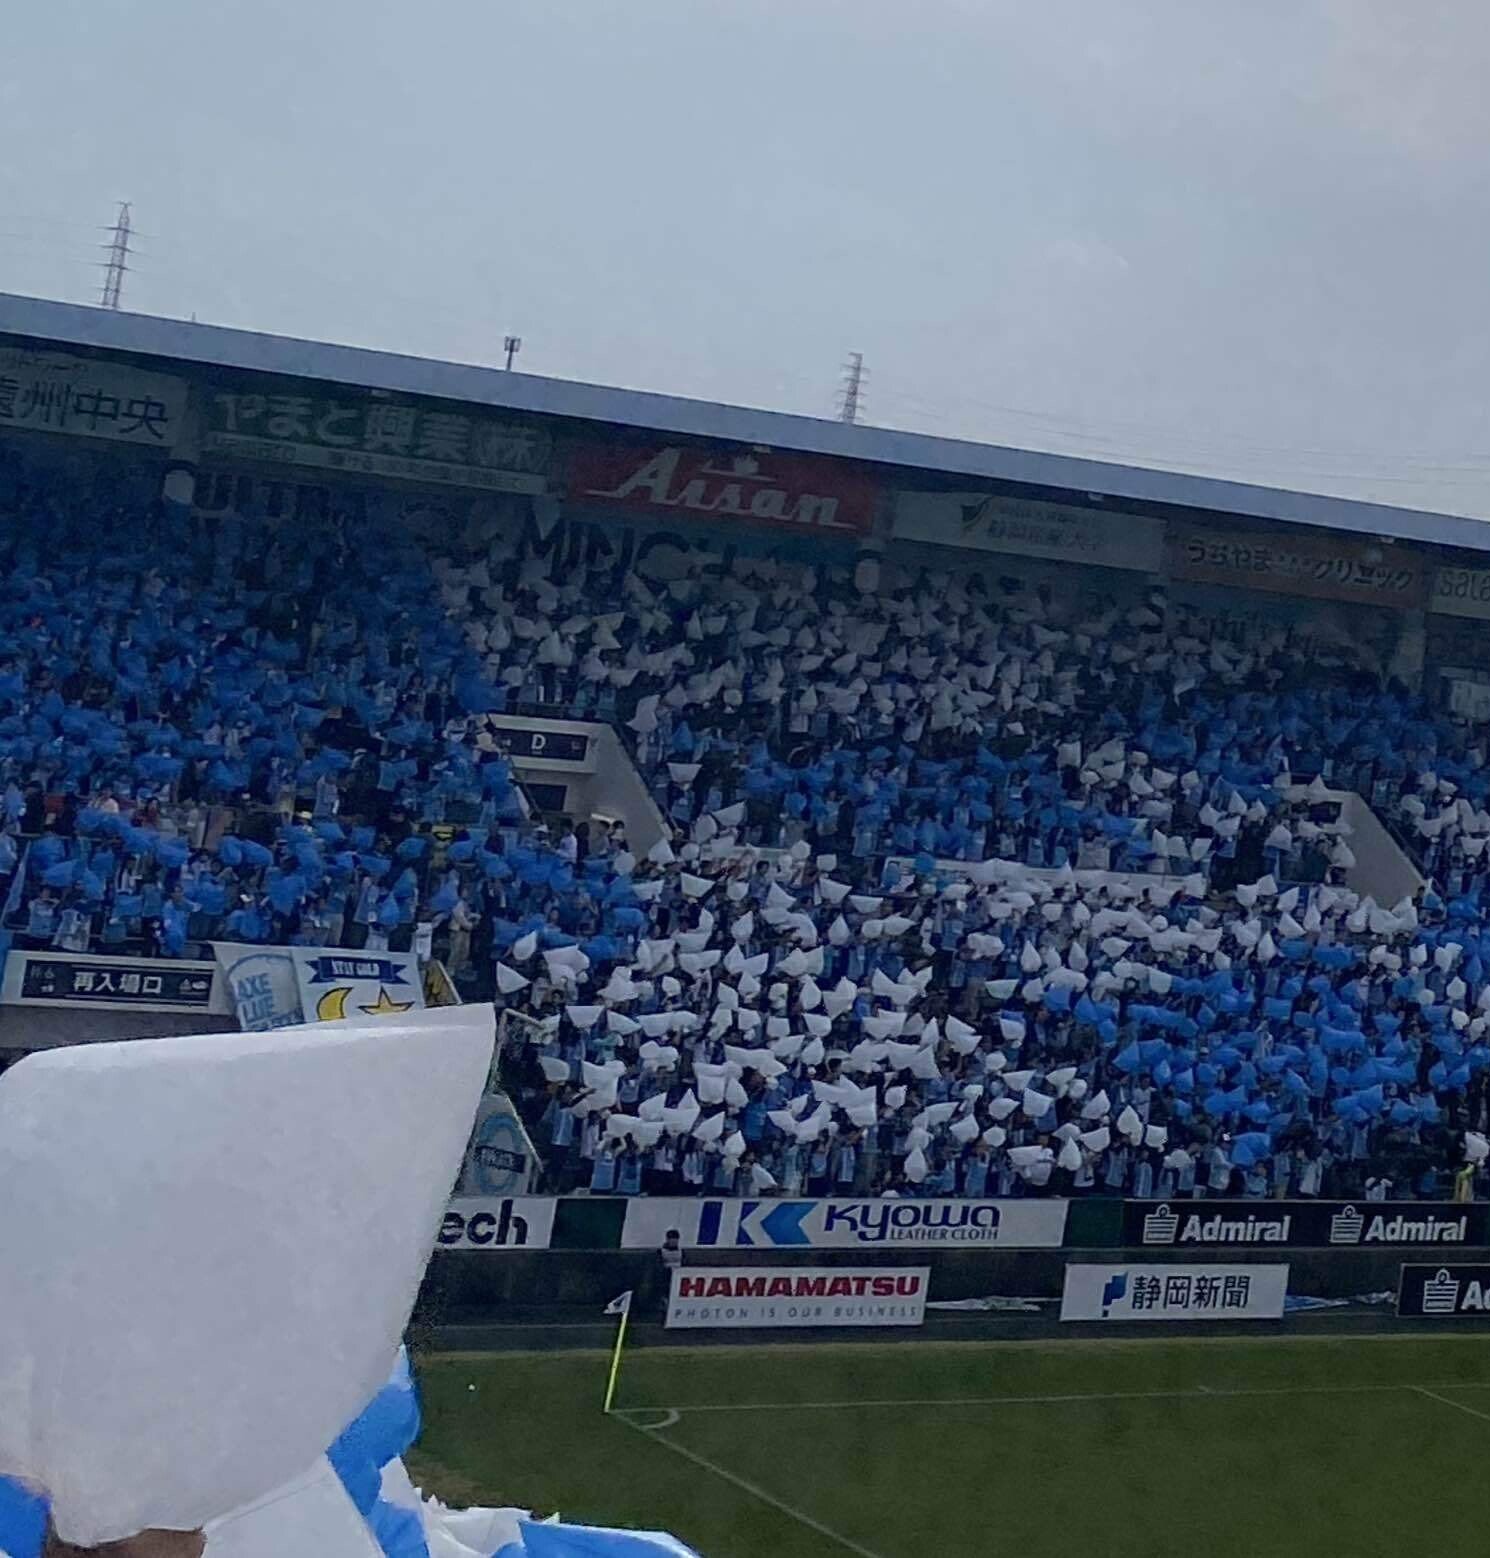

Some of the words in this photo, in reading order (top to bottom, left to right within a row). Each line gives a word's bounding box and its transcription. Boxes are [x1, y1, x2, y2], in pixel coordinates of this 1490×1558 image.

[531, 734, 546, 749] D
[73, 971, 162, 994] 再入場口
[890, 1229, 948, 1241] LEATHER
[951, 1229, 999, 1241] CLOTH
[1180, 1215, 1291, 1241] Admiral
[1365, 1215, 1466, 1241] Admiral
[679, 1276, 921, 1297] HAMAMATSU
[1132, 1274, 1251, 1309] 静岡新聞
[674, 1307, 749, 1319] PHOTON
[760, 1307, 776, 1318] IS
[788, 1306, 822, 1318] OUR
[834, 1305, 917, 1317] BUSINESS
